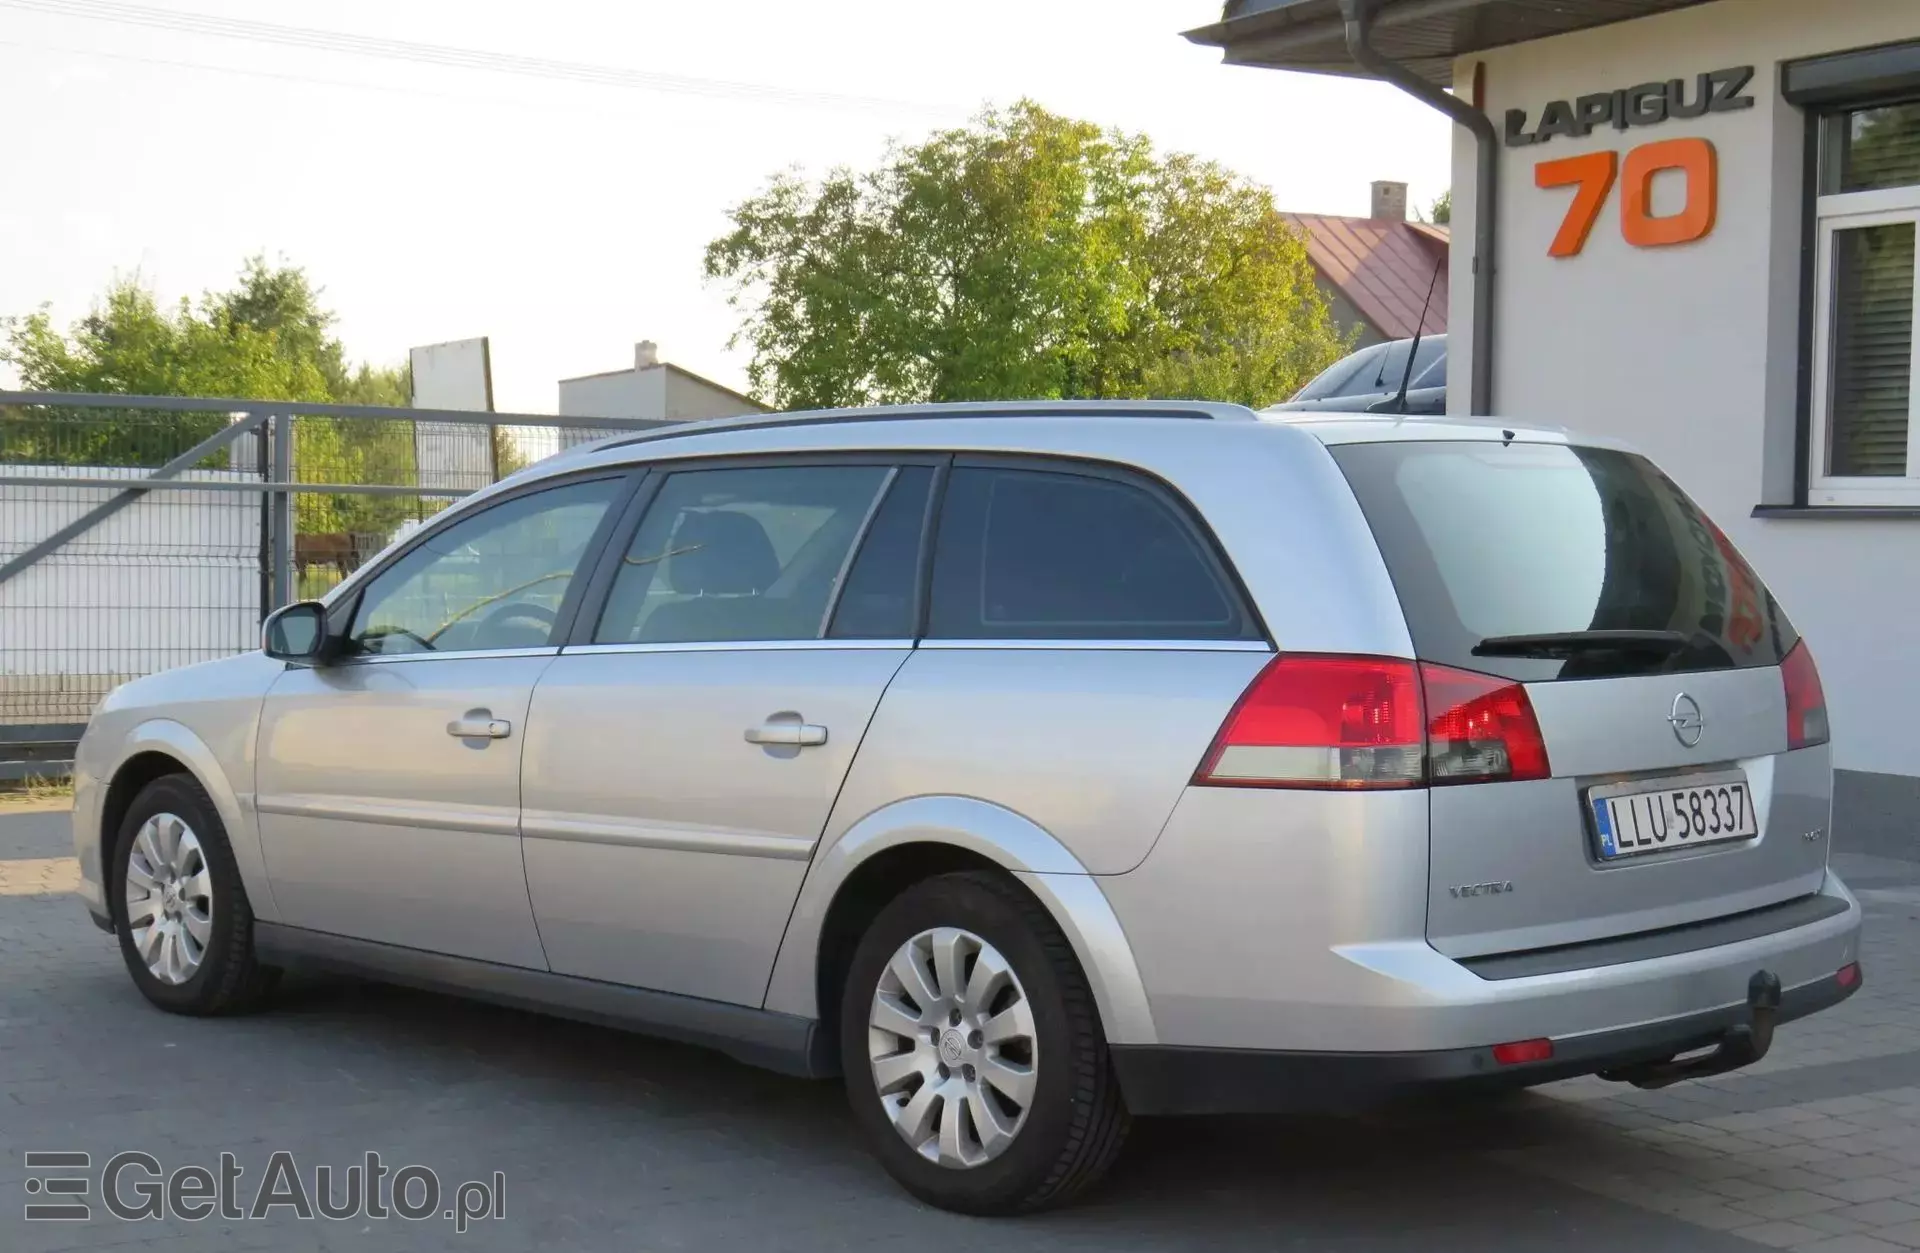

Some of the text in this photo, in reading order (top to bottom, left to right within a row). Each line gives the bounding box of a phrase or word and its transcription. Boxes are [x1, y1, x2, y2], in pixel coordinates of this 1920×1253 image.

[1535, 137, 1718, 257] 70
[1601, 833, 1613, 847] PL
[1449, 881, 1513, 899] VECTRA
